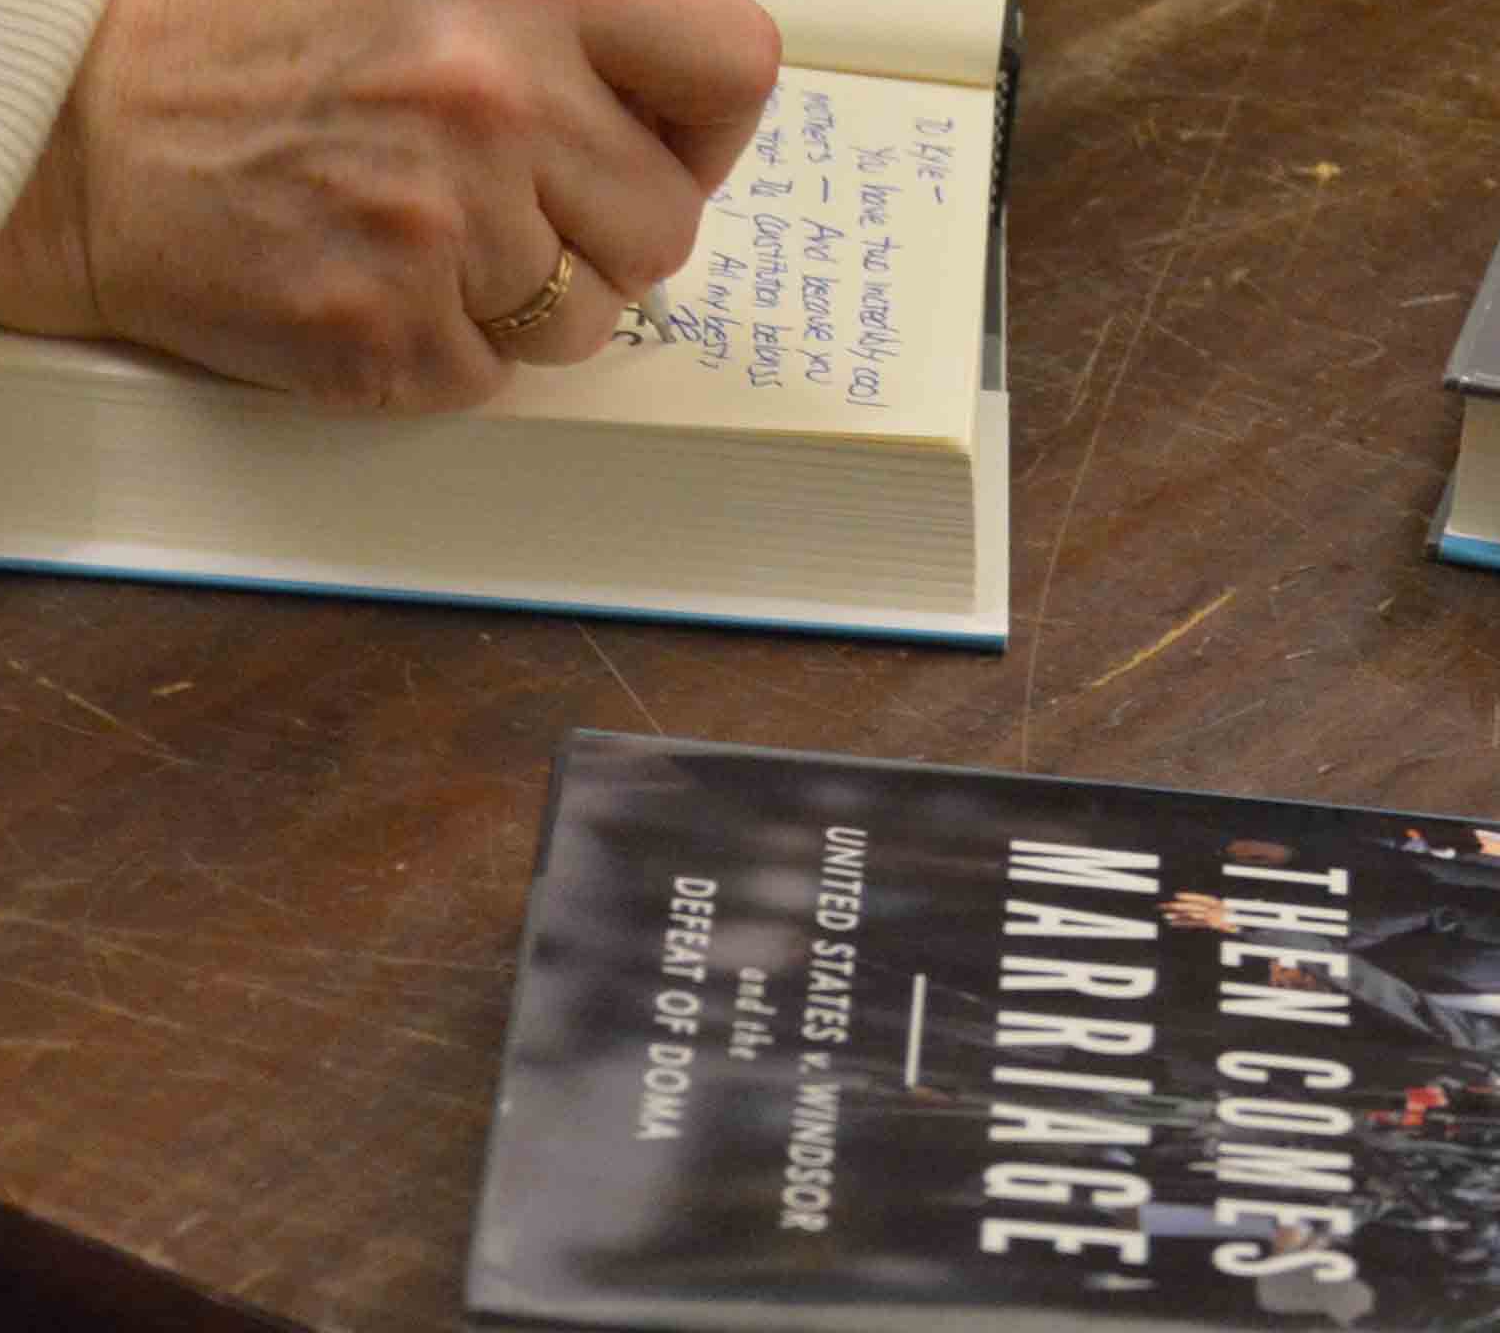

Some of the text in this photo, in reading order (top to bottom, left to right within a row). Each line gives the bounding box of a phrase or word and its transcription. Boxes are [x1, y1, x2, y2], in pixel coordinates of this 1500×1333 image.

[858, 183, 904, 228] have
[801, 275, 842, 341] because
[845, 367, 891, 408] cool
[812, 824, 869, 929] UNITED
[636, 875, 718, 1141] DEFEAT OF DOMA
[727, 966, 776, 1063] and the
[801, 938, 857, 1045] STATES
[979, 839, 1161, 1266] MARRIAGE
[1212, 862, 1358, 1285] THEN COMES
[778, 1083, 842, 1234] WINDSOR
